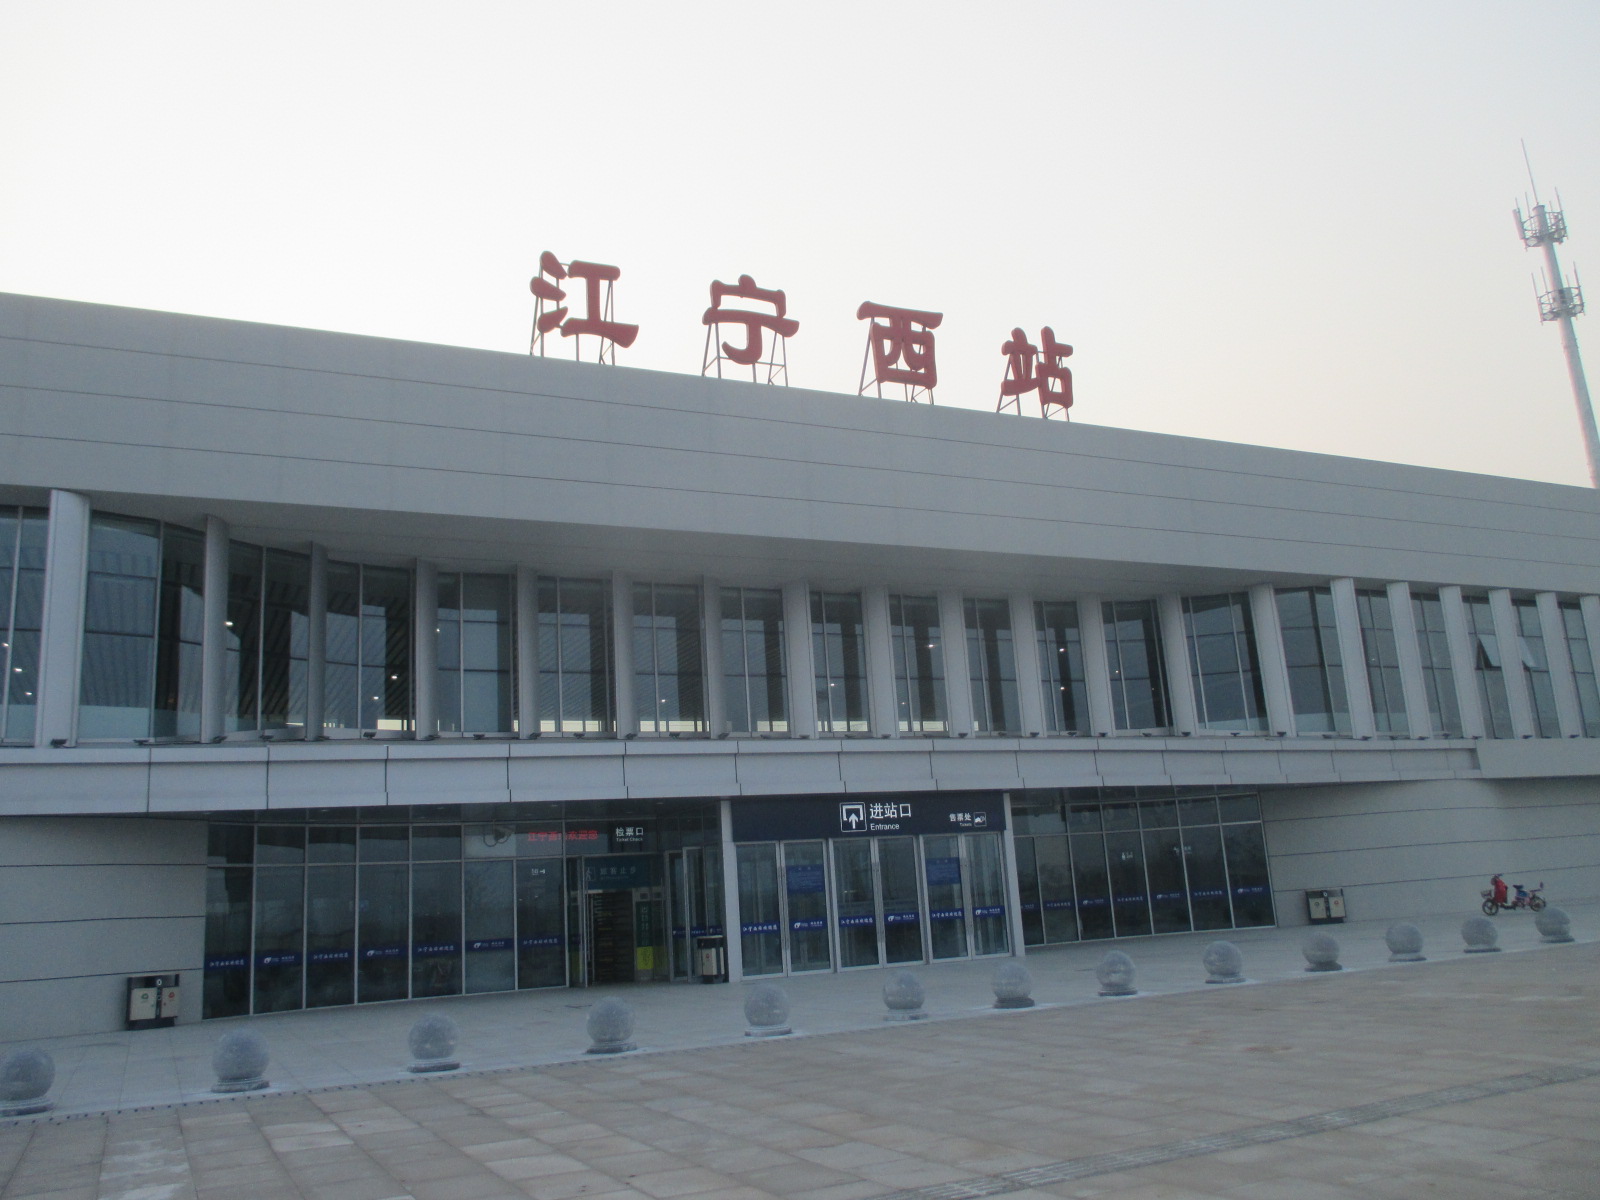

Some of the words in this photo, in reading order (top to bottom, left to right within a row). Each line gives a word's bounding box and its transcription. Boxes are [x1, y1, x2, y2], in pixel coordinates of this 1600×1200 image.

[530, 250, 1074, 409] 江宁西站
[869, 802, 911, 819] 进站口
[949, 812, 972, 822] 售票处
[870, 822, 900, 831] Entrance
[615, 827, 644, 837] 检票口
